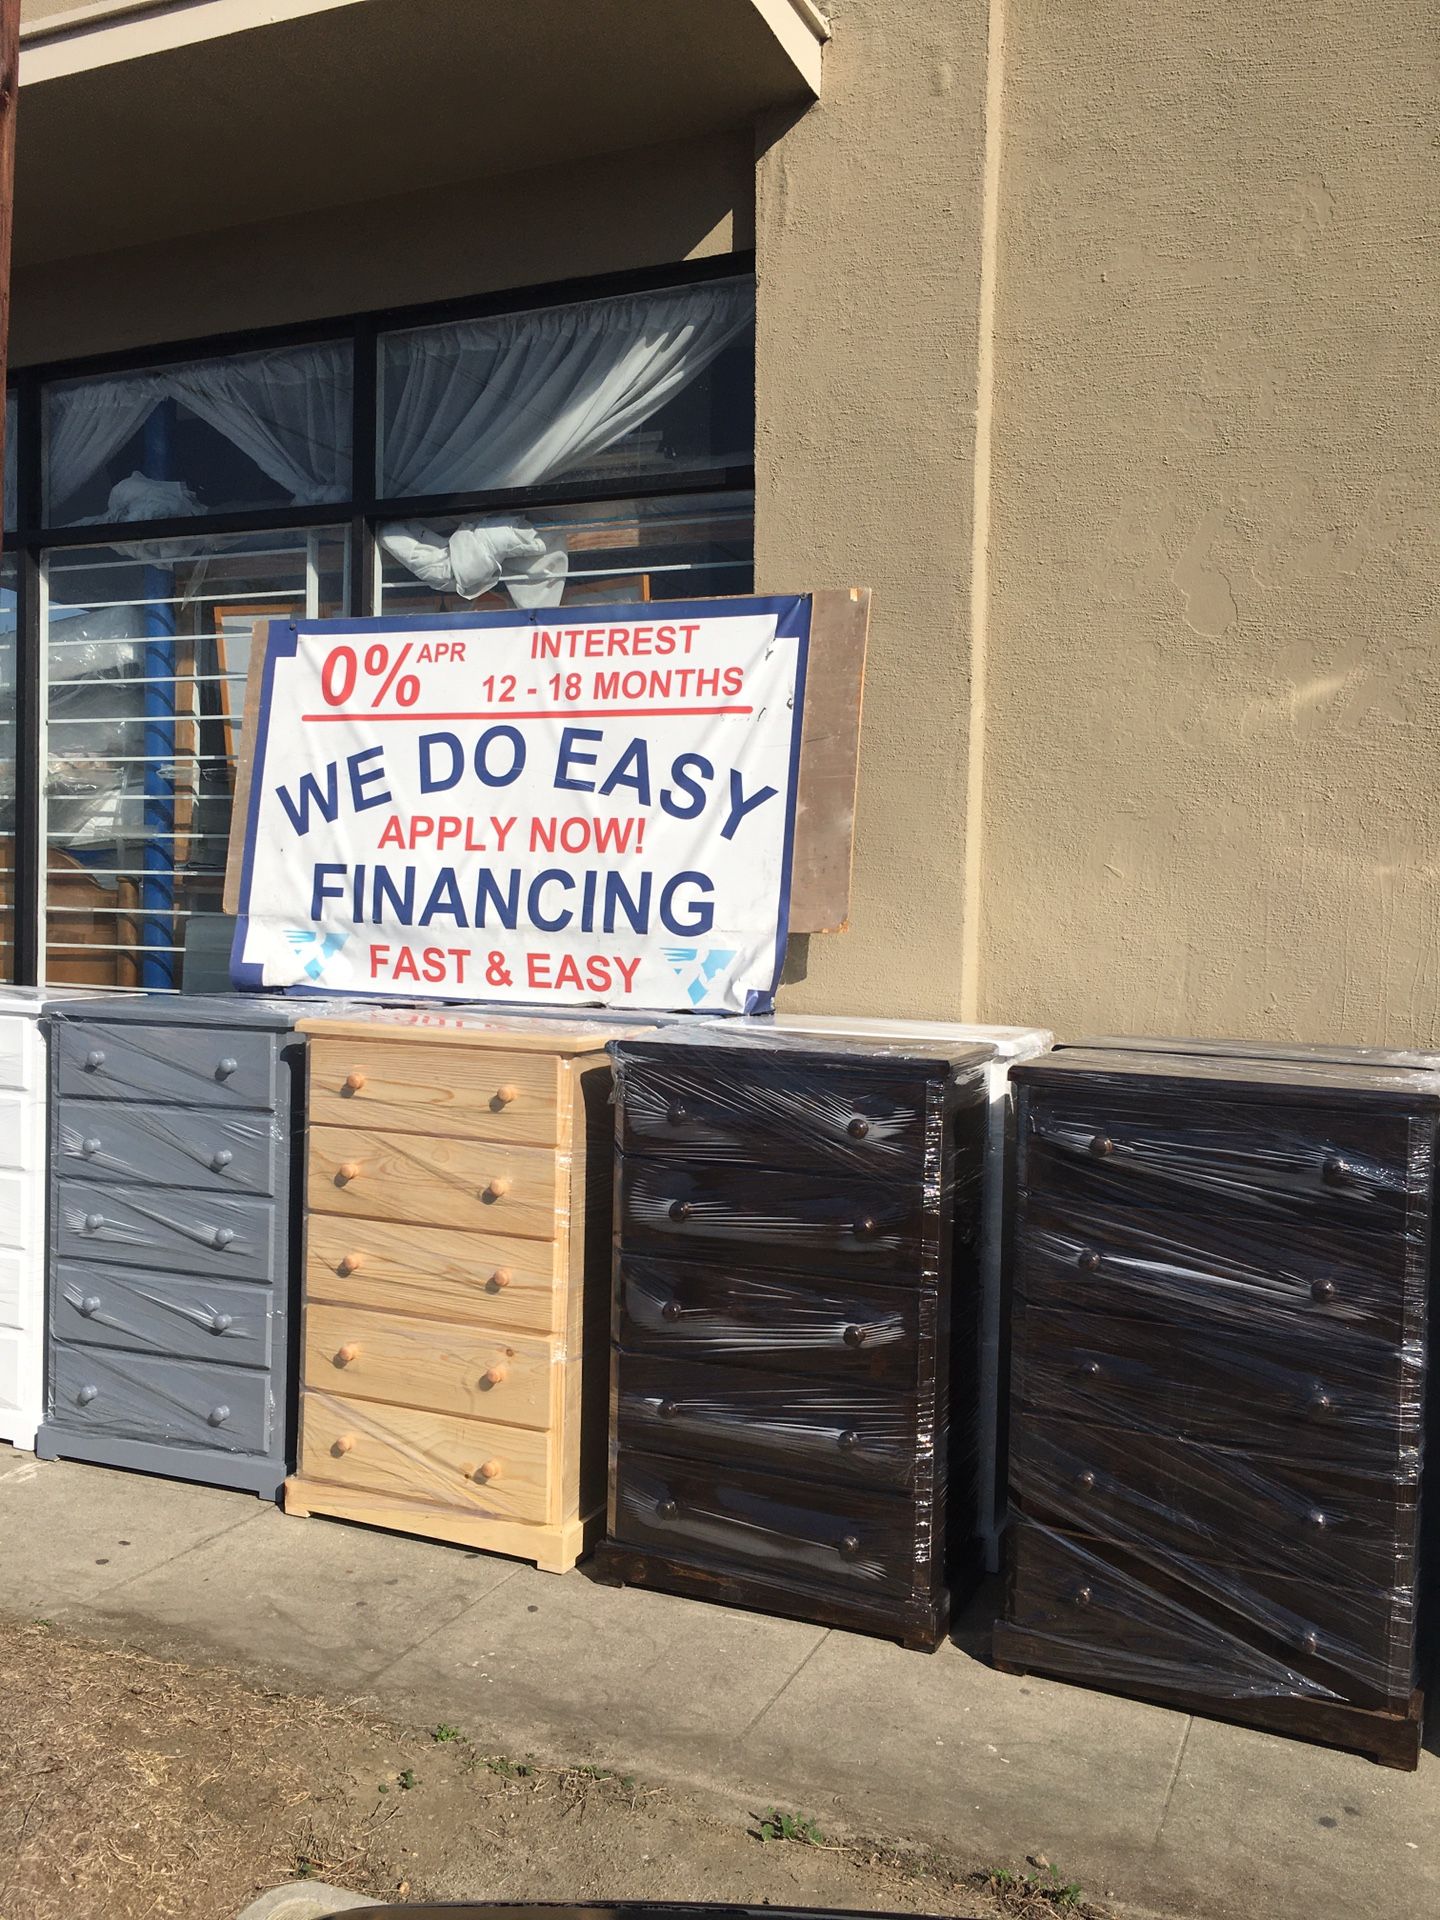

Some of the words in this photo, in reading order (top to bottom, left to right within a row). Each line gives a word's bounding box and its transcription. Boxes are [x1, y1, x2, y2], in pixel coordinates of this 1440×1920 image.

[530, 624, 701, 660] INTEREST
[320, 642, 422, 708] 0%
[416, 641, 466, 663] APR
[482, 674, 517, 703] 12
[549, 672, 583, 702] 18
[592, 666, 744, 700] MONTHS
[275, 745, 392, 836] WE
[418, 724, 526, 794] DO
[553, 727, 777, 839] EASY
[377, 815, 517, 853] APPLY
[528, 816, 647, 855] NOW!
[309, 863, 715, 937] FINANCING
[369, 943, 472, 984] FAST
[484, 950, 513, 987] &
[526, 952, 641, 993] EASY
